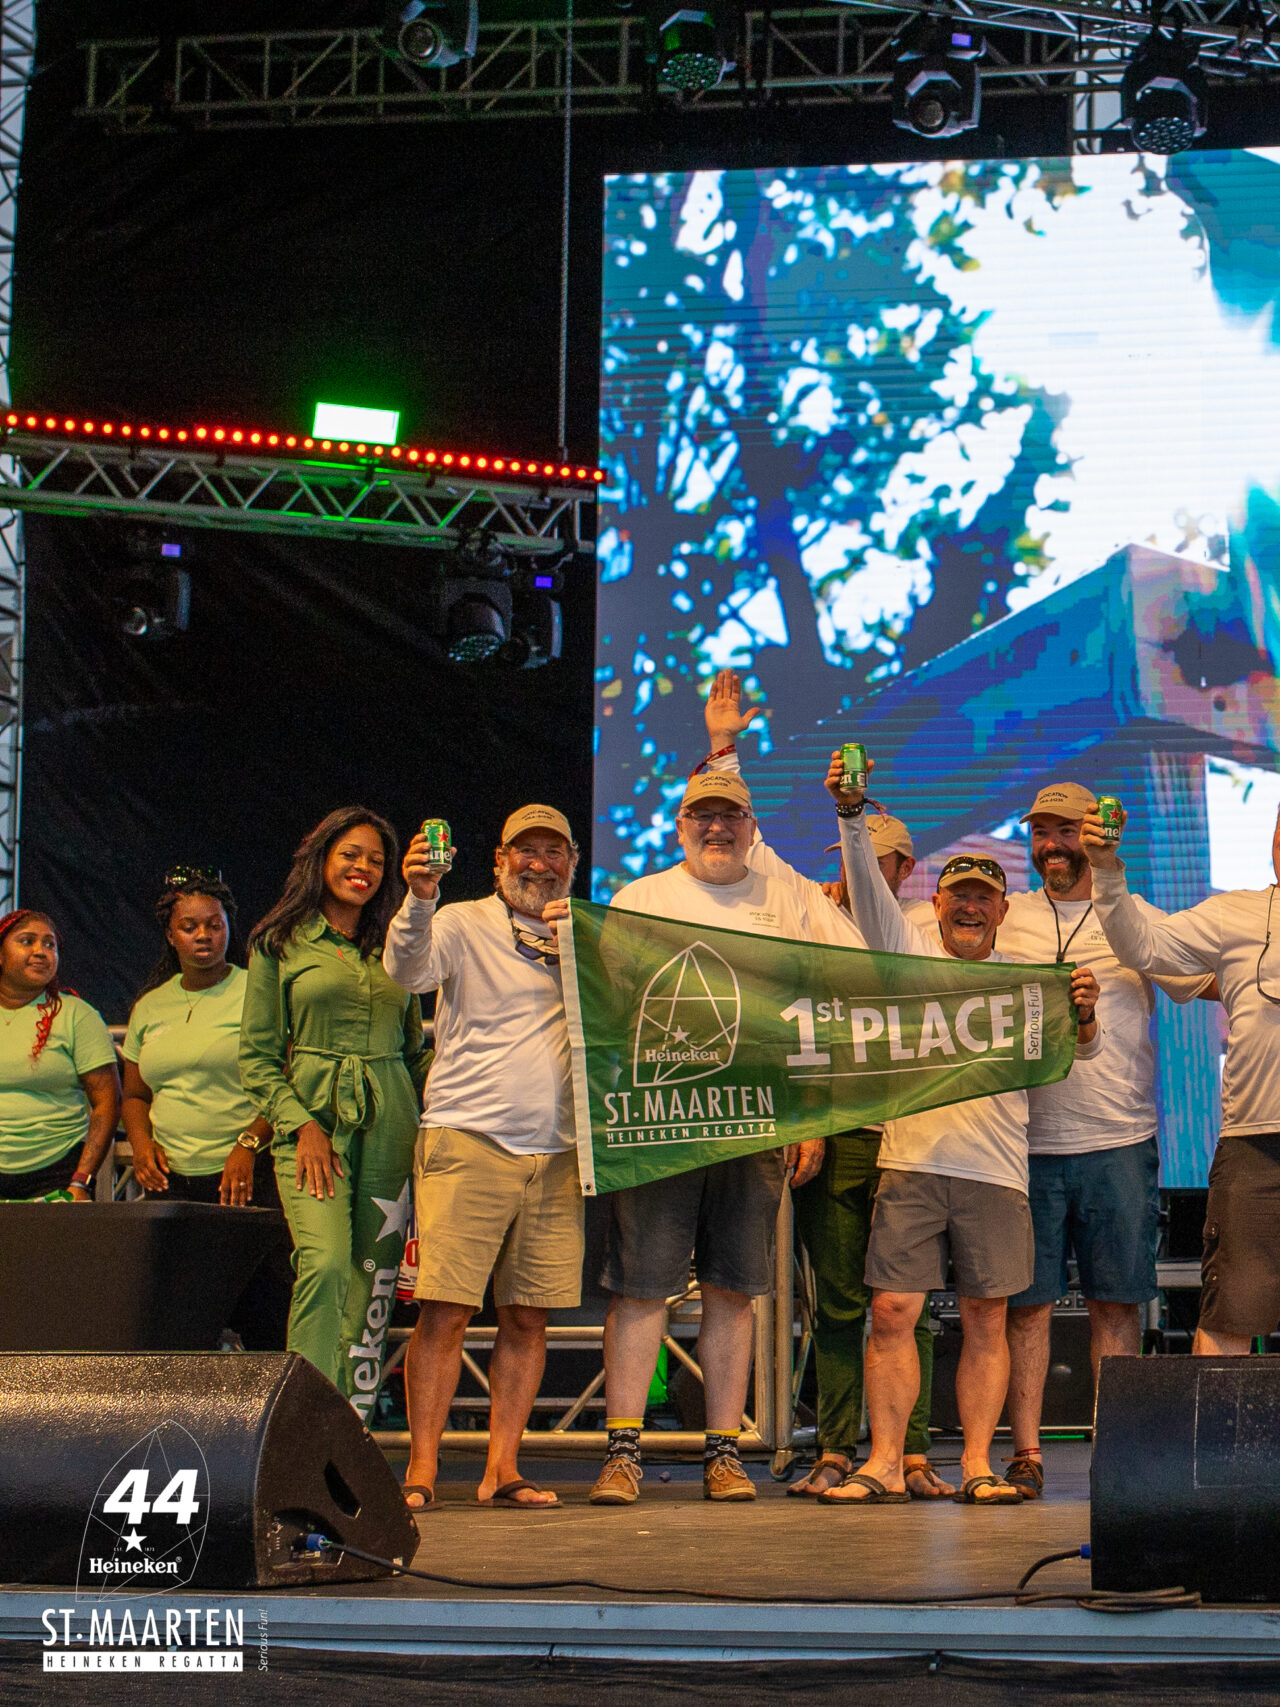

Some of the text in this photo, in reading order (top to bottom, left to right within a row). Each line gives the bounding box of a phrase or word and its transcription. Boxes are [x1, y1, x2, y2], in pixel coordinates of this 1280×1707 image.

[780, 994, 1015, 1067] 1st PLACE
[1028, 1011, 1040, 1056] Serious
[645, 1048, 720, 1063] Heineken
[607, 1123, 776, 1143] HEINEKEN REGATTA
